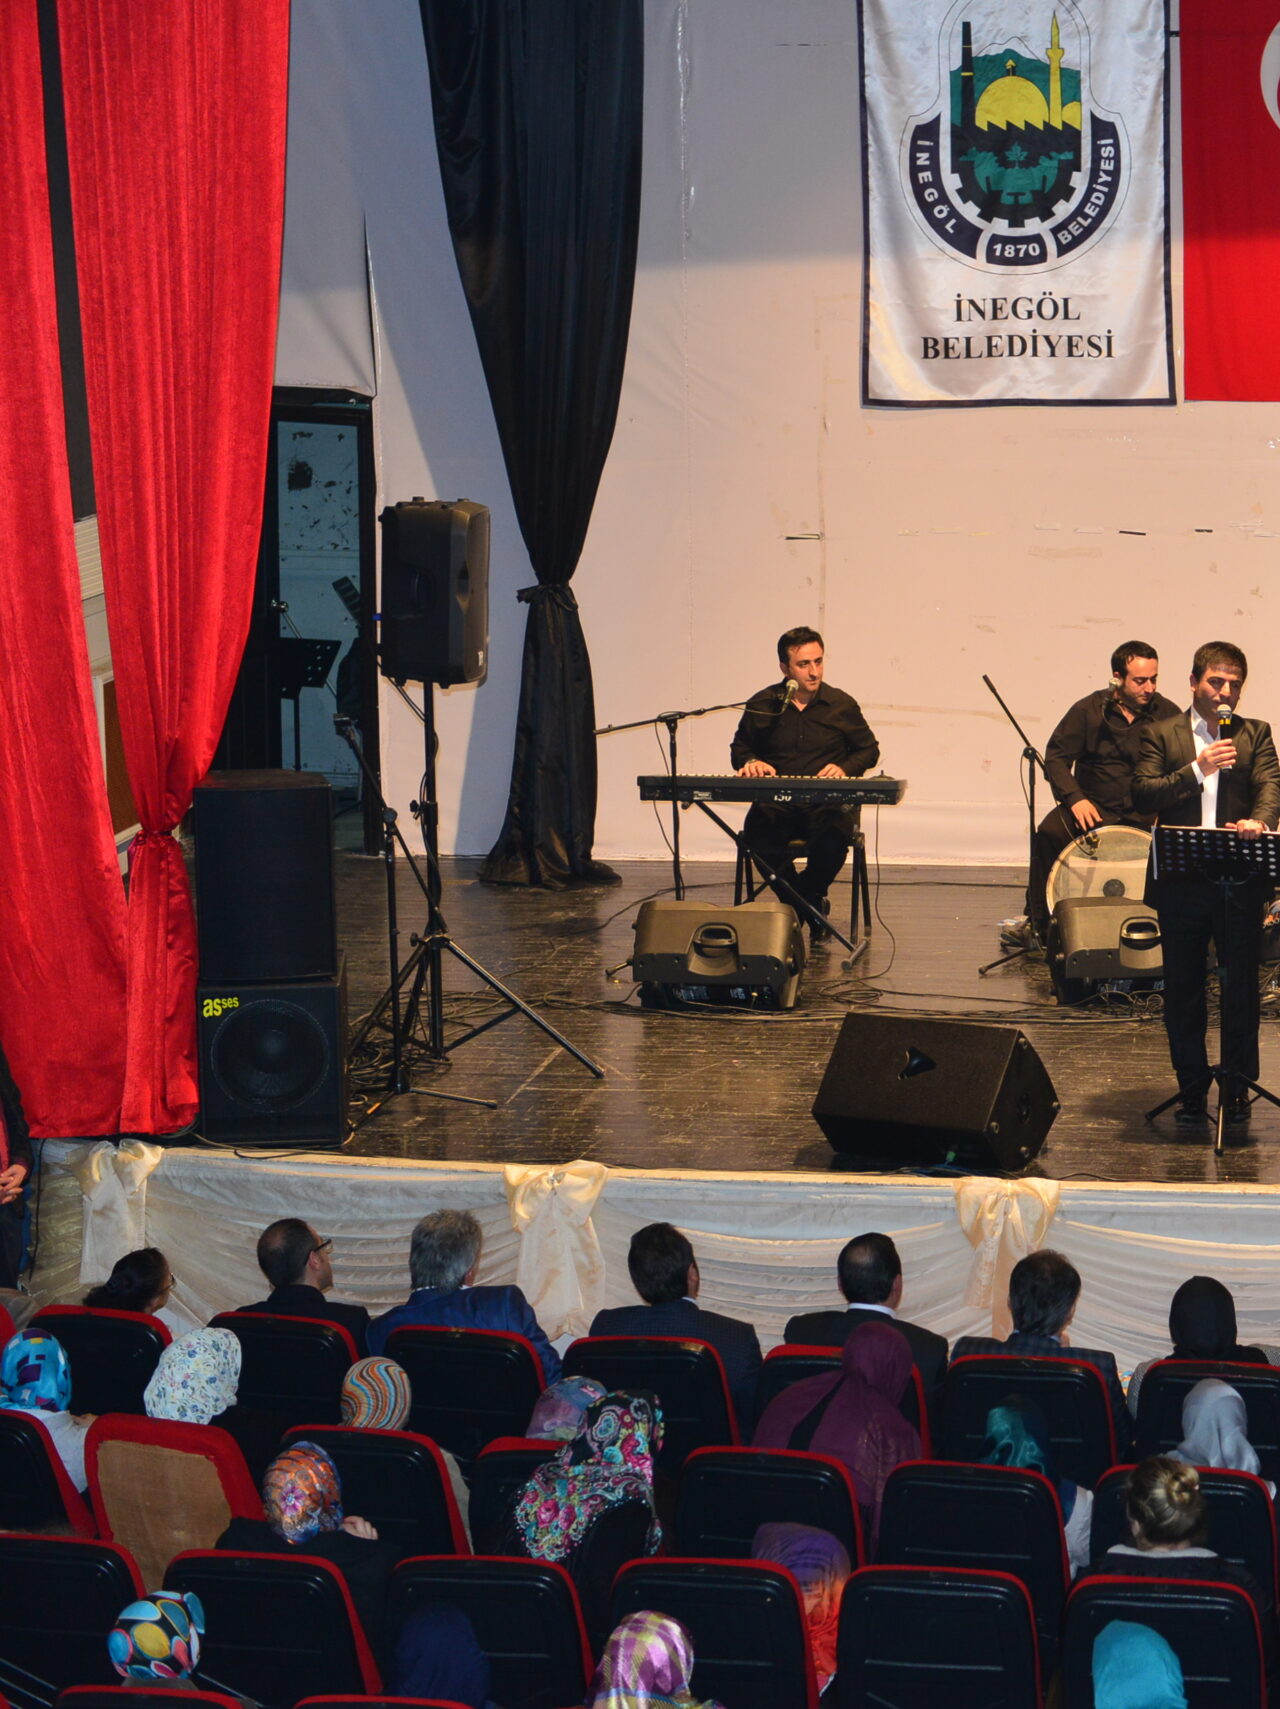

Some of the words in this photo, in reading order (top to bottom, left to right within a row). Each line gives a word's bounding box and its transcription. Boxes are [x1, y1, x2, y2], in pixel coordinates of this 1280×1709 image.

[916, 140, 957, 234] İNEGÖL
[1058, 138, 1115, 245] BELEDİYESİ
[993, 243, 1041, 258] 1870
[954, 291, 1081, 322] İNEGÖL
[921, 329, 1115, 360] BELEDİYESİ
